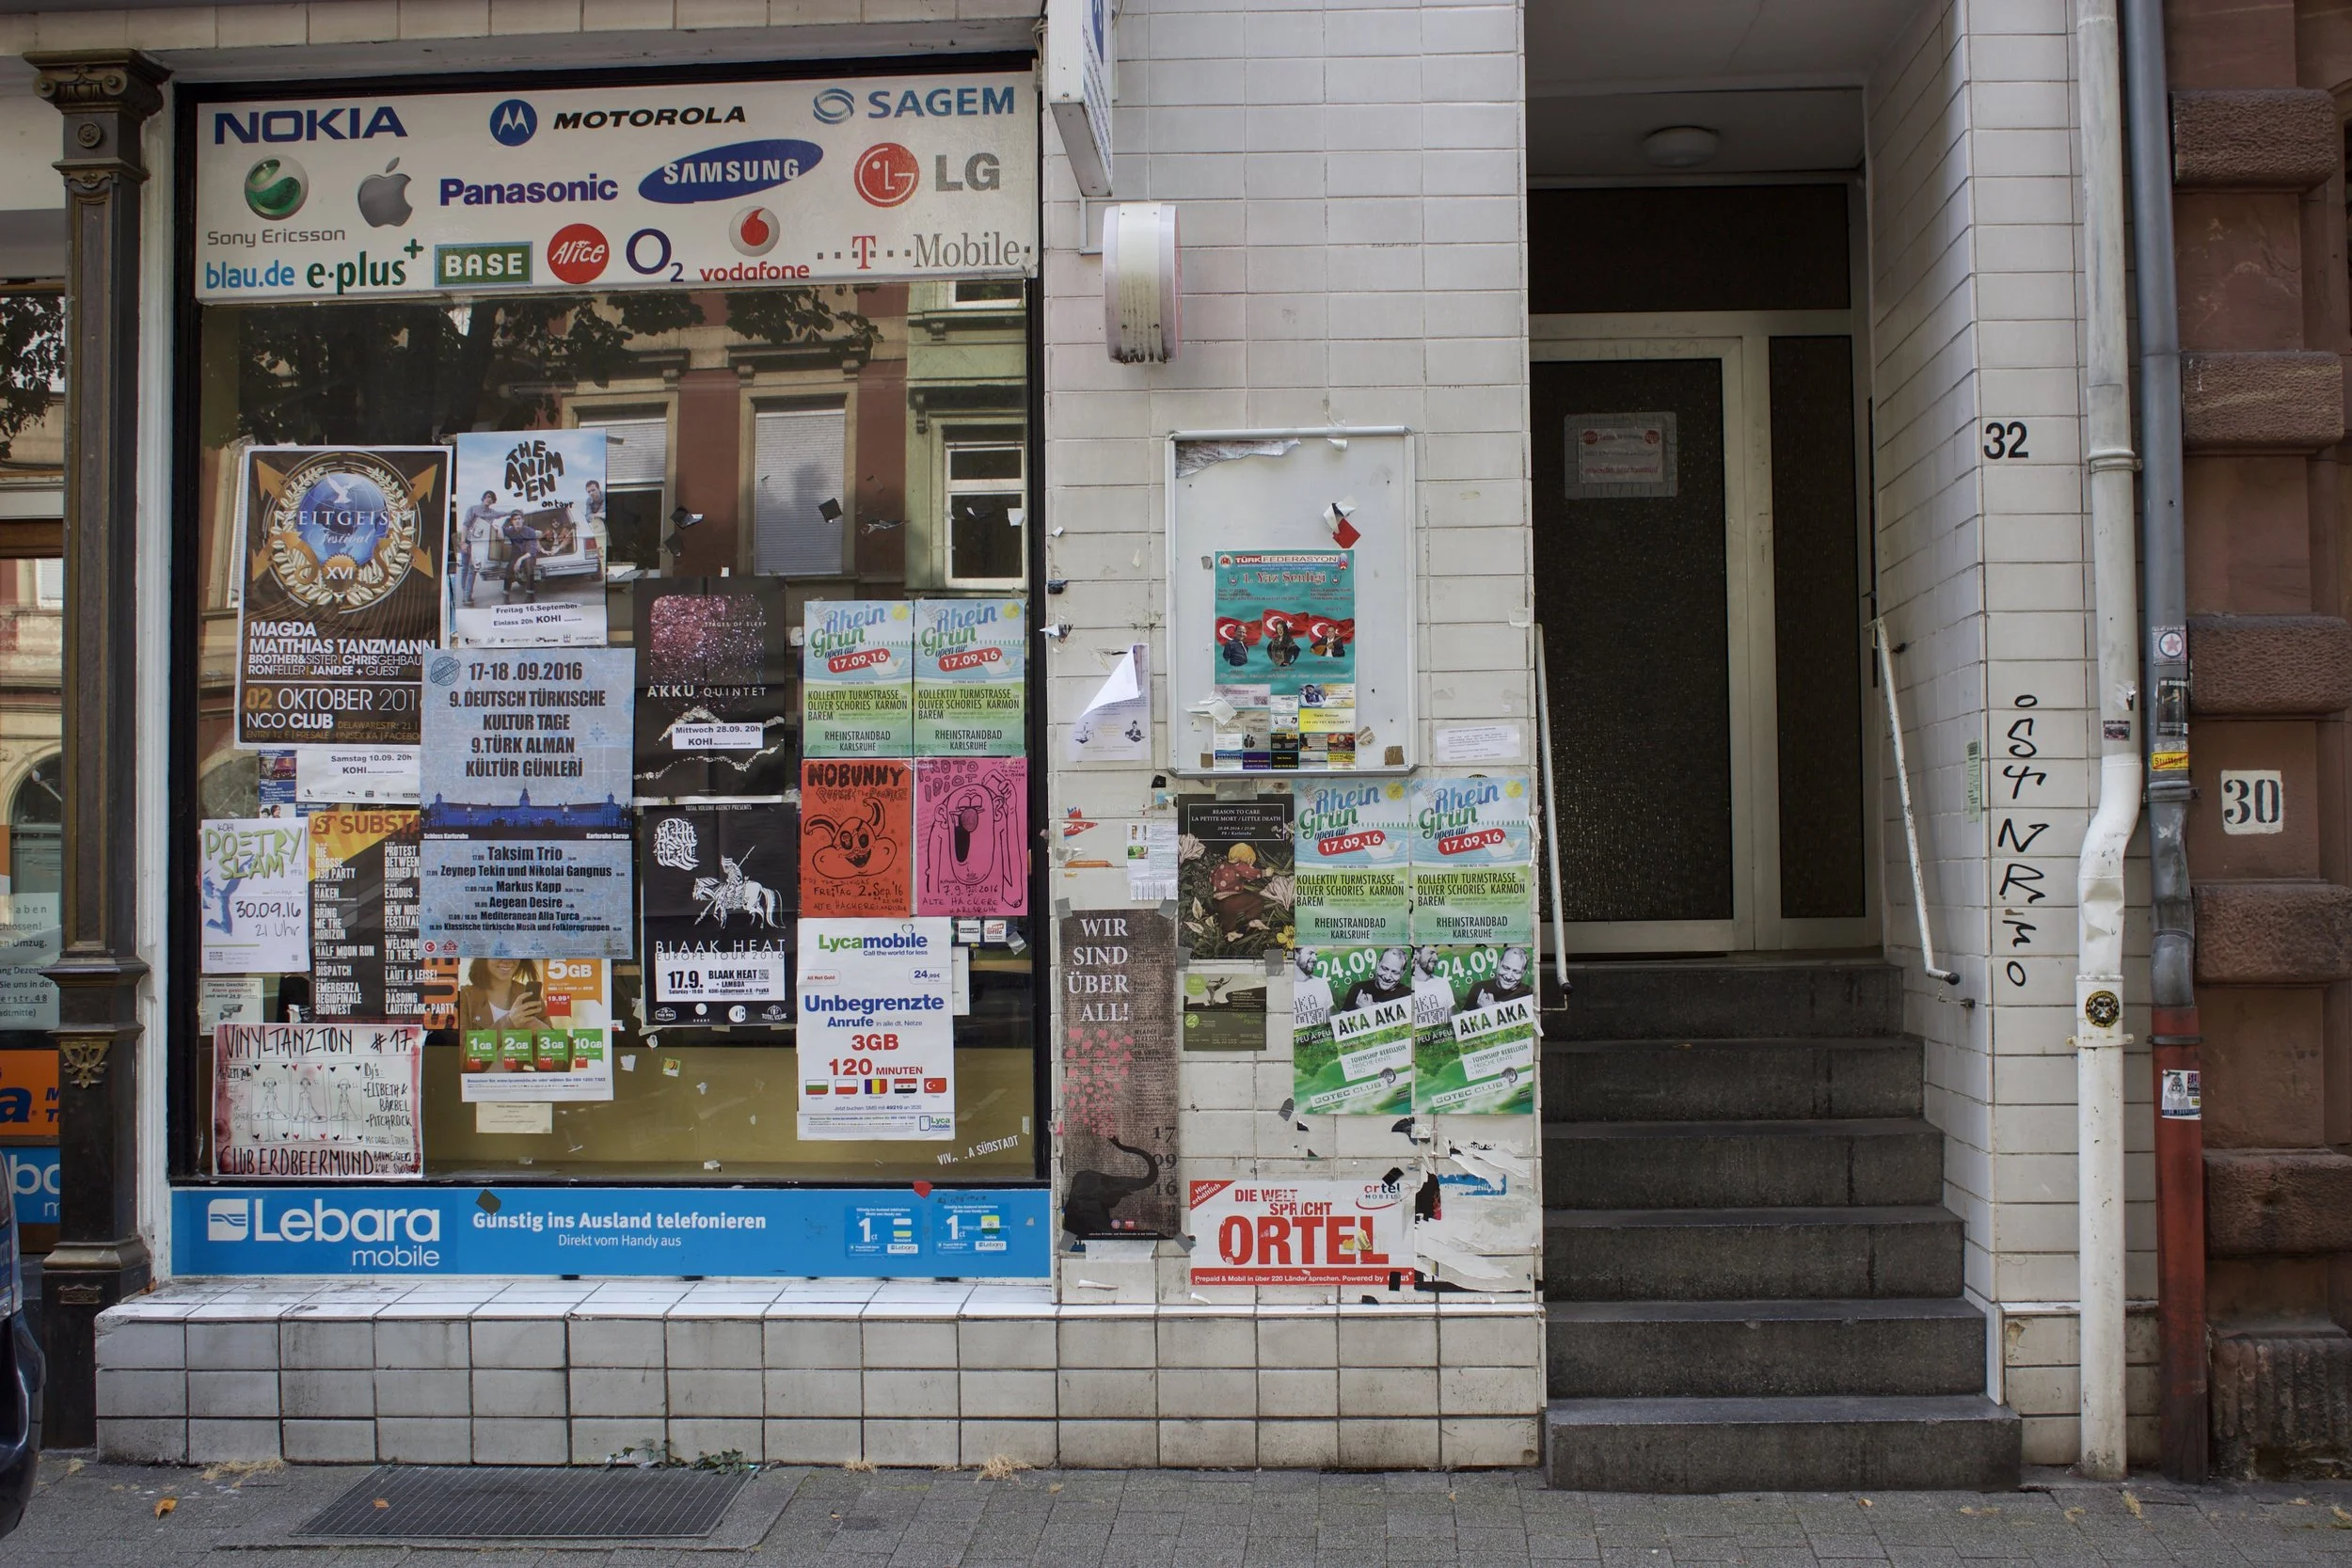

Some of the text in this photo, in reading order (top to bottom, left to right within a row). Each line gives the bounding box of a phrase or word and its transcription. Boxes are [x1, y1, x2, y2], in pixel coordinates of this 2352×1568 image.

[867, 87, 1015, 119] SAGEM
[215, 106, 408, 144] NOKIA
[553, 106, 745, 130] MOTOROLA
[663, 158, 800, 185] SAMSUNG
[935, 152, 1000, 191] LG
[440, 173, 618, 206] Panasonic
[207, 229, 345, 247] Sony Ericsson
[551, 239, 606, 265] Alice
[445, 251, 522, 277] BASE
[700, 261, 809, 281] vodafone
[206, 260, 294, 289] blau.de
[1983, 421, 2028, 459] 32
[506, 440, 546, 464] THE
[326, 567, 353, 579] XVI
[525, 604, 578, 612] 16.September
[536, 615, 562, 624] KOHI
[826, 604, 885, 633] Rhein
[251, 622, 317, 637] MAGDA
[250, 641, 333, 654] MATTHIAS
[249, 655, 338, 664] BROTHER&SISTER
[834, 652, 887, 670] 17.09.16
[310, 666, 353, 675] JANDEE
[366, 666, 400, 675] GUEST
[246, 688, 373, 710] 02 OKTOBER
[450, 689, 605, 706] 9. DEUTSCH TÜRKISCHE
[647, 686, 767, 697] AKKU QUINTET
[808, 689, 898, 700] KOLLEKTIV TURMSTRASSE
[808, 700, 907, 710] OLIVER SCHORIES KARMON
[246, 713, 333, 728] NCO CLUB
[484, 715, 570, 730] KULTUR TAGE
[808, 711, 834, 721] BAREM
[471, 736, 574, 753] 9.TÜRK ALMAN
[825, 731, 890, 740] RHEINSTRANDBAD
[840, 742, 876, 751] KARLSRUHE
[466, 758, 582, 776] KÜLTÜR GÜNLERİ
[808, 765, 904, 786] NOBUNNY
[1435, 781, 1500, 815] Rhein
[2224, 779, 2280, 824] 30
[204, 827, 303, 864] POETRY
[1443, 832, 1502, 851] 17.09.16
[488, 847, 563, 861] Taksim Trio
[219, 852, 284, 879] SLAM
[441, 865, 612, 878] Zeynep Tekin und Nikolai Gangnus
[1418, 873, 1516, 885] KOLLEKTIV TURMSTRASSE
[315, 888, 339, 898] HAKEN
[1418, 883, 1525, 895] OLIVER SCHORIES KARMON
[236, 902, 301, 918] 30.09.16
[315, 908, 338, 918] BRING
[256, 921, 299, 938] 21 Uhr
[315, 919, 342, 928] ME THE
[1081, 918, 1128, 936] WIR
[1437, 916, 1507, 927] RHEINSTRANDBAD
[315, 929, 345, 940] HORIZON
[818, 932, 928, 952] Lycamobile
[1453, 928, 1492, 938] KARLSRUHE
[657, 940, 785, 953] BLAAK HEAT
[1073, 946, 1128, 965] SIND
[316, 966, 351, 976] DISPATCH
[668, 970, 757, 988] 17.9. BLAAK HEAT
[1068, 972, 1129, 993] ÜBER
[805, 994, 944, 1014] Unbegrenzte
[1079, 1004, 1129, 1022] ALL!
[827, 1016, 873, 1027] Anrufe
[1460, 1003, 1529, 1036] AKA AKA
[851, 1035, 898, 1051] 3GB
[1351, 1045, 1406, 1063] TOWNSHIP REBELLION
[829, 1058, 872, 1075] 120
[220, 1146, 373, 1176] CLUB ERDBEERMUND
[1192, 1183, 1221, 1206] erhältlich
[1195, 1182, 1211, 1195] Hier
[1235, 1190, 1257, 1202] DIE
[255, 1199, 439, 1242] Lebara
[473, 1211, 766, 1231] Günstig ins Ausland telefonieren
[559, 1233, 681, 1249] Direkt vom Handy aus
[1219, 1215, 1389, 1265] ORTEL
[353, 1245, 439, 1266] mobile
